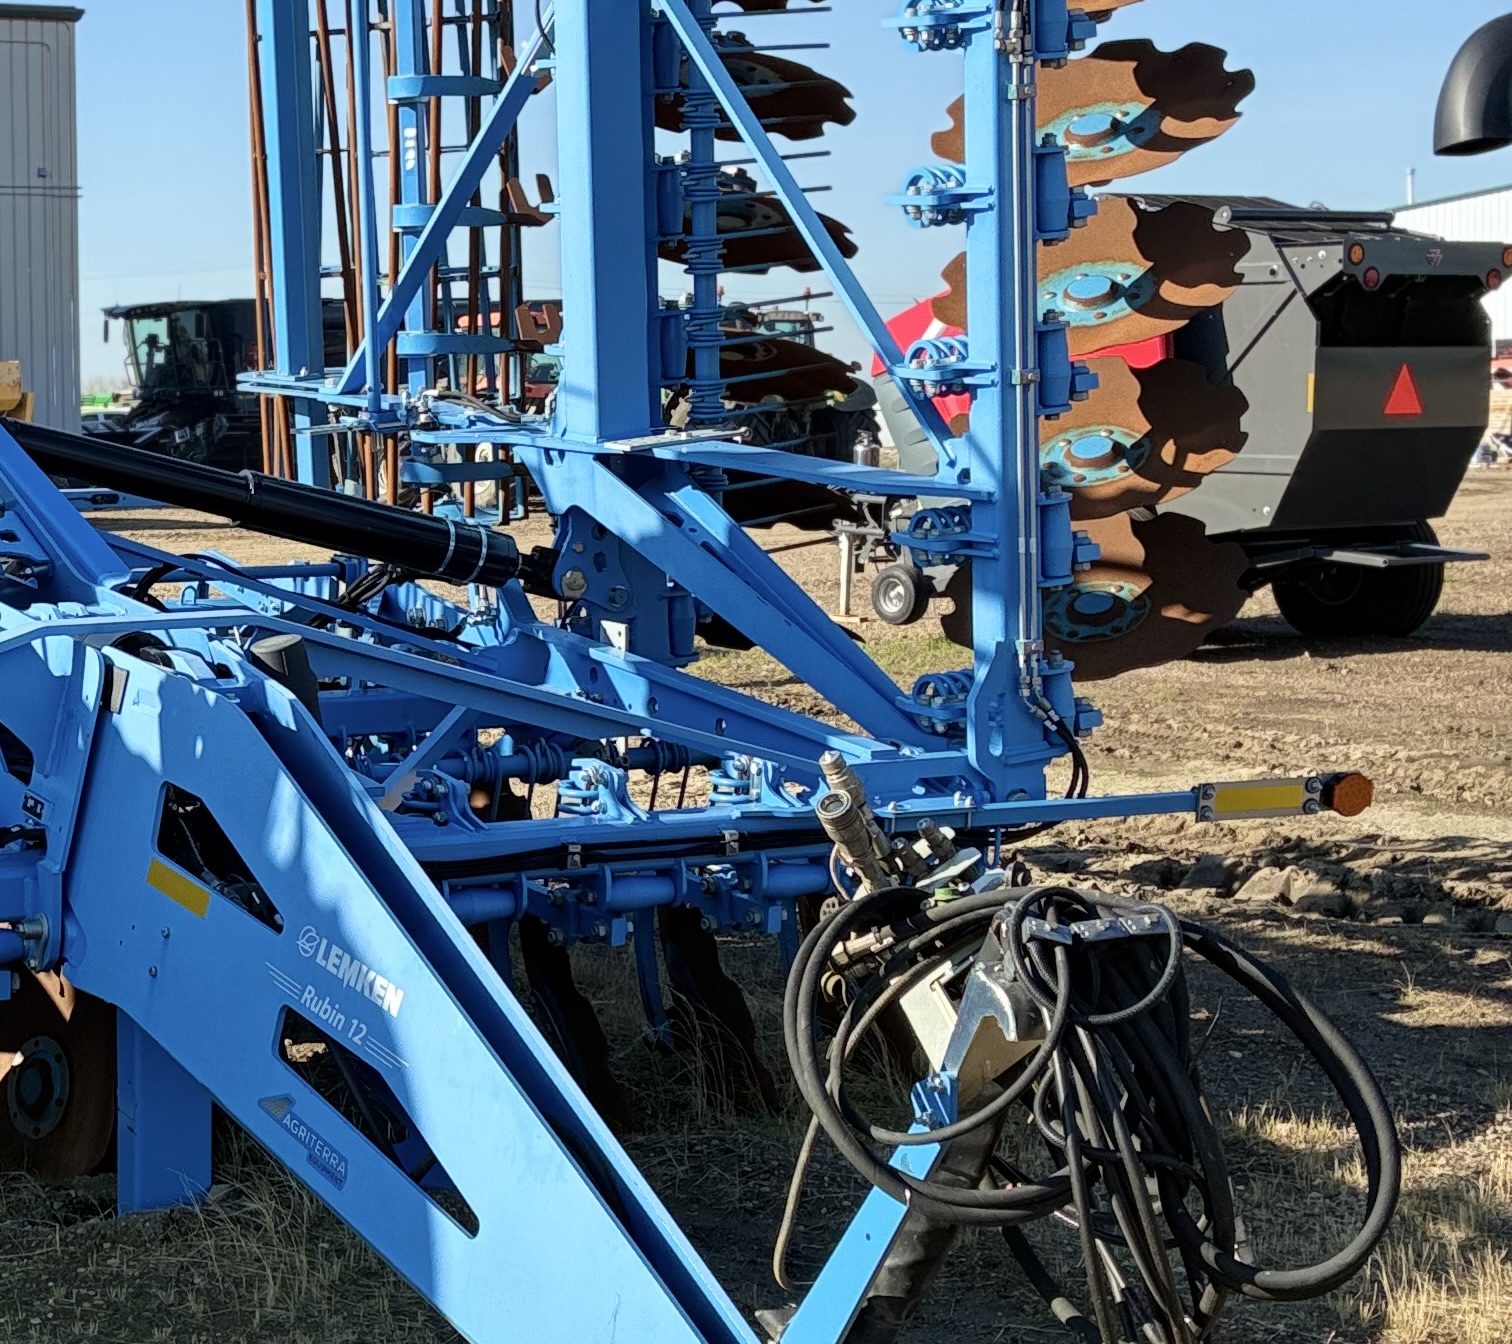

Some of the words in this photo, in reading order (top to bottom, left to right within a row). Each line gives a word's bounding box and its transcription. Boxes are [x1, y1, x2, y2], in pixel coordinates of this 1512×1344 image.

[315, 937, 405, 1019] LEMKEN
[300, 984, 346, 1032] Rubin
[348, 1018, 368, 1047] 12
[281, 1113, 345, 1176] AGRITERRA
